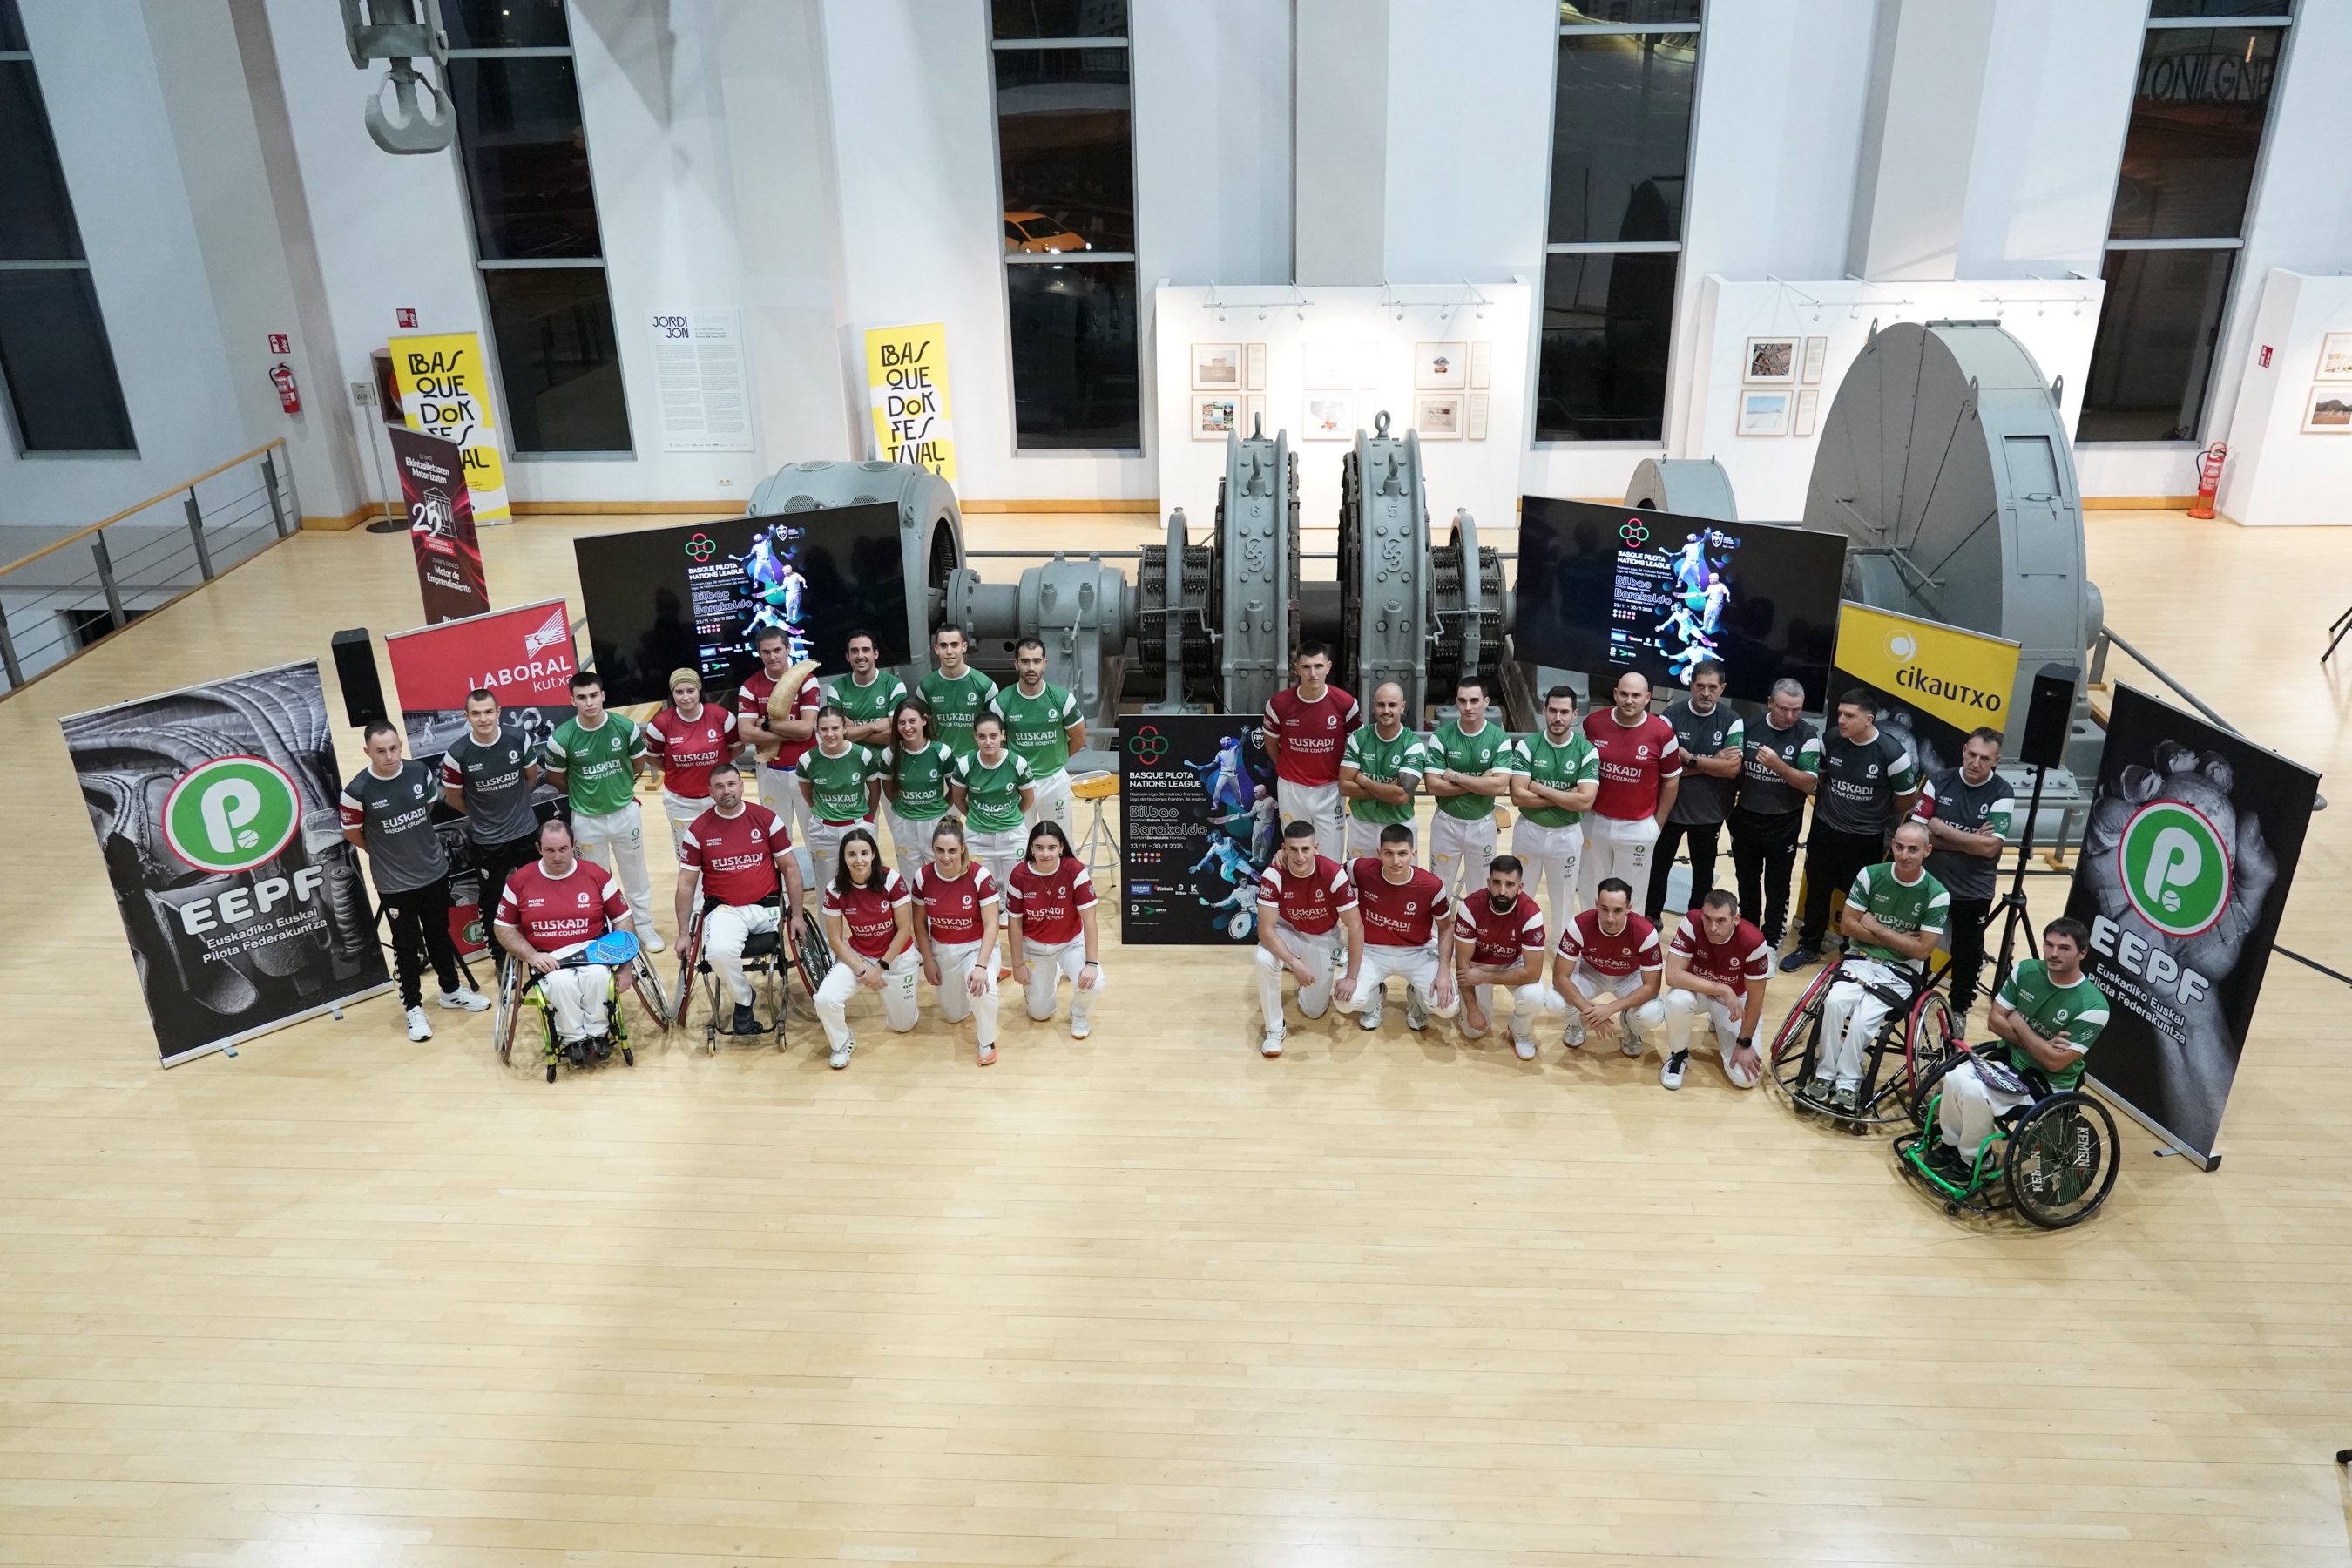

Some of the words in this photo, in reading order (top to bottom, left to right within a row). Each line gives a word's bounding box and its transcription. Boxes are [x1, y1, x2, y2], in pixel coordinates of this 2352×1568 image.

[653, 316, 687, 327] JORDI
[666, 328, 689, 338] JON
[881, 341, 930, 367] BAS
[408, 350, 463, 375] BAS
[886, 366, 932, 390] QUE
[416, 375, 468, 399] QUE
[891, 416, 934, 443] FES
[412, 468, 429, 479] Motor
[429, 473, 447, 484] izaten
[1250, 504, 1260, 517] 6
[1388, 504, 1398, 517] 5
[429, 543, 453, 553] ANIVERSARIO
[1618, 551, 1644, 560] BASQUE
[1644, 553, 1666, 563] PILOTA
[1618, 557, 1645, 565] NATIONS
[1646, 560, 1671, 569] LEAGUE
[435, 565, 451, 578] Motor
[452, 571, 460, 580] de
[688, 565, 715, 575] BASQUE
[716, 563, 738, 571] PILOTA
[689, 571, 719, 580] NATIONS
[720, 568, 744, 577] LEAGUE
[427, 572, 471, 593] Emprendimiento
[1615, 576, 1652, 589] Bilbao
[692, 590, 730, 602] Bilbao
[1614, 588, 1672, 605] Barakaldo
[693, 599, 753, 615] Barakaldo
[469, 655, 572, 691] LABORAL
[532, 673, 573, 693] kutxa
[1015, 730, 1057, 740] EUSKADI
[1288, 738, 1335, 747] EUSKADI
[672, 751, 719, 762] EUSKADI
[582, 759, 621, 775] EUSKADI
[1598, 760, 1642, 778] USKADI
[476, 770, 520, 787] EUSKADI
[1612, 775, 1640, 784] COUNTRY
[820, 793, 858, 802] EUSKADI
[898, 789, 937, 800] EUSKADI
[381, 807, 426, 828] EUSKADI
[1129, 805, 1179, 818] Bilbao
[384, 826, 407, 835] BASQUE
[1129, 823, 1208, 835] Barakaldo
[711, 853, 763, 868] EUSKADI
[179, 865, 326, 935] EEPF
[531, 918, 589, 930] EUSKADI
[850, 917, 895, 933] EUSKADI
[929, 916, 973, 926] EUSKADI
[206, 922, 274, 950] Euskadiko
[275, 908, 319, 932] Euskal
[558, 928, 589, 936] COUNTRY
[202, 944, 240, 964] Pilota
[242, 918, 328, 955] Federakuntza
[2088, 913, 2210, 1005] EEPF
[2020, 989, 2035, 1000] PILOTA
[2095, 963, 2149, 1004] Euskadiko
[2150, 995, 2186, 1028] Euskal
[2088, 973, 2117, 999] Pilota
[2117, 989, 2186, 1045] Federakuntza
[2077, 1126, 2091, 1167] KEMEN
